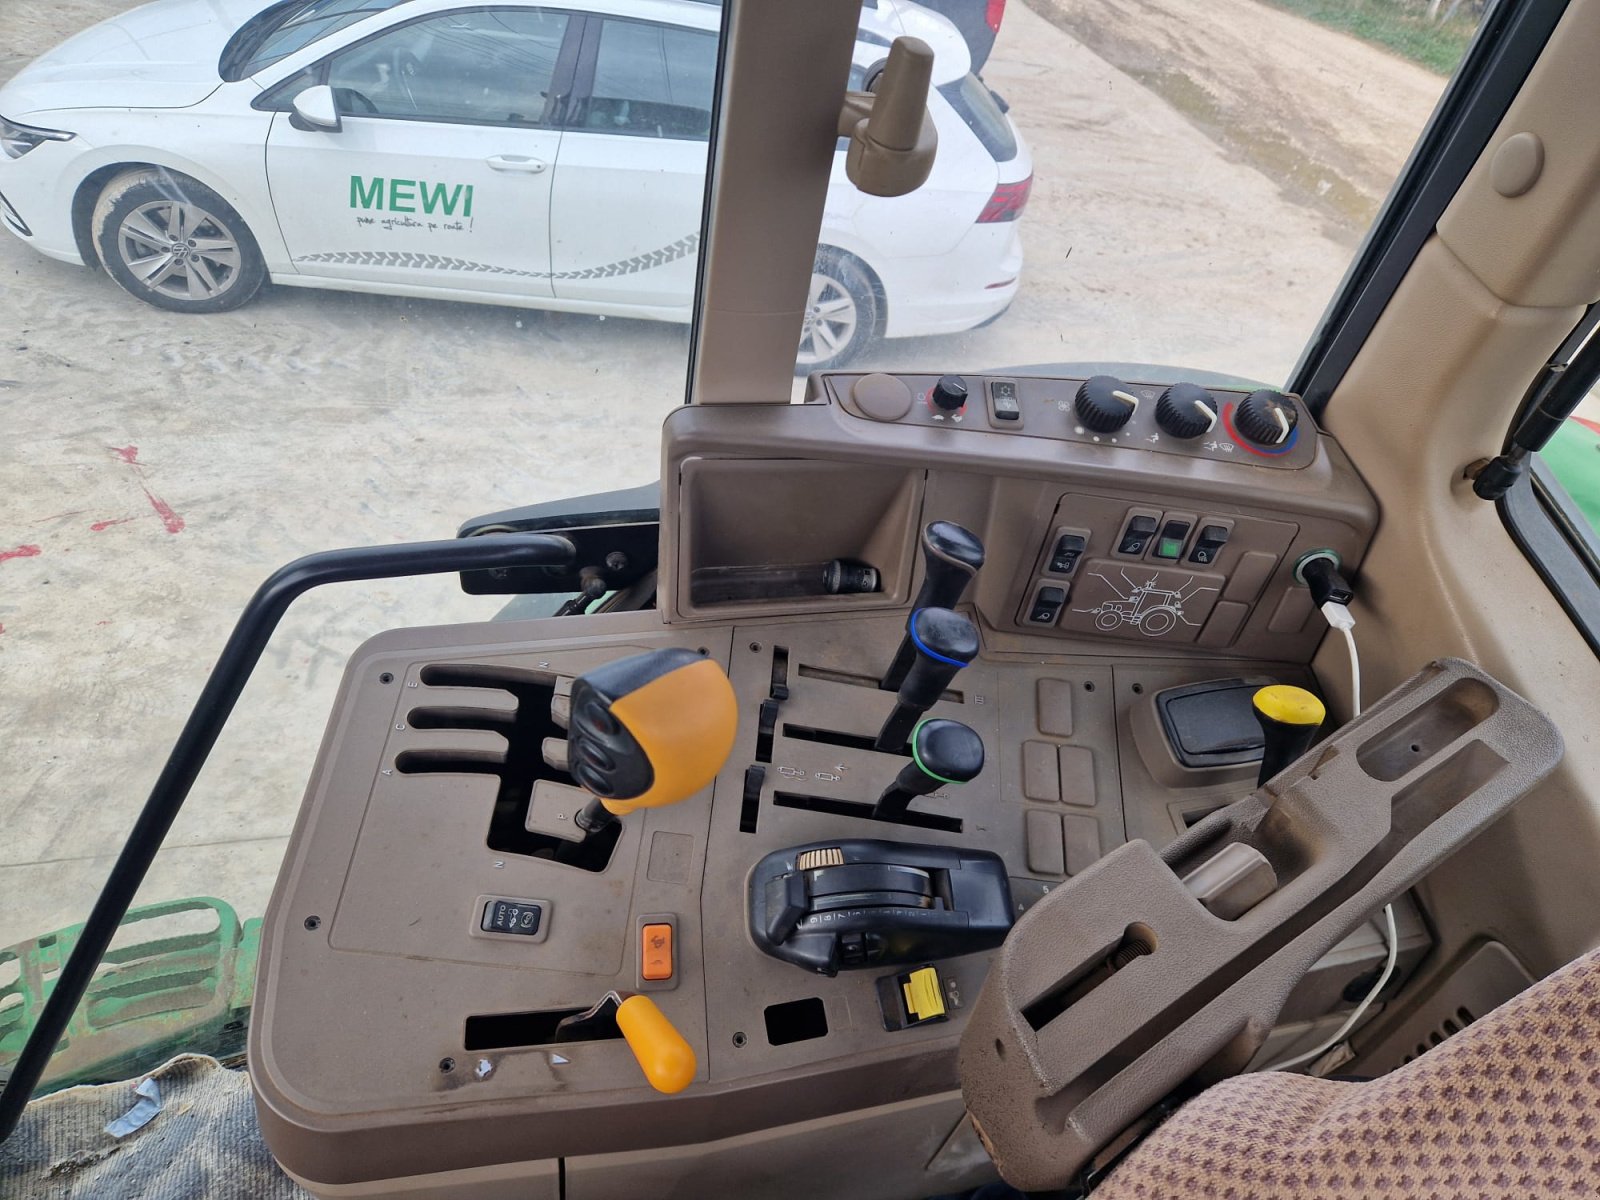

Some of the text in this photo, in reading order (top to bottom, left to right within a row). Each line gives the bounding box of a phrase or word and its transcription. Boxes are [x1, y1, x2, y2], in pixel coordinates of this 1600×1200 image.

[350, 175, 473, 217] MEWI
[381, 216, 423, 230] agricultura
[428, 222, 438, 232] pe
[1042, 885, 1049, 894] 5
[496, 904, 506, 926] AUTO
